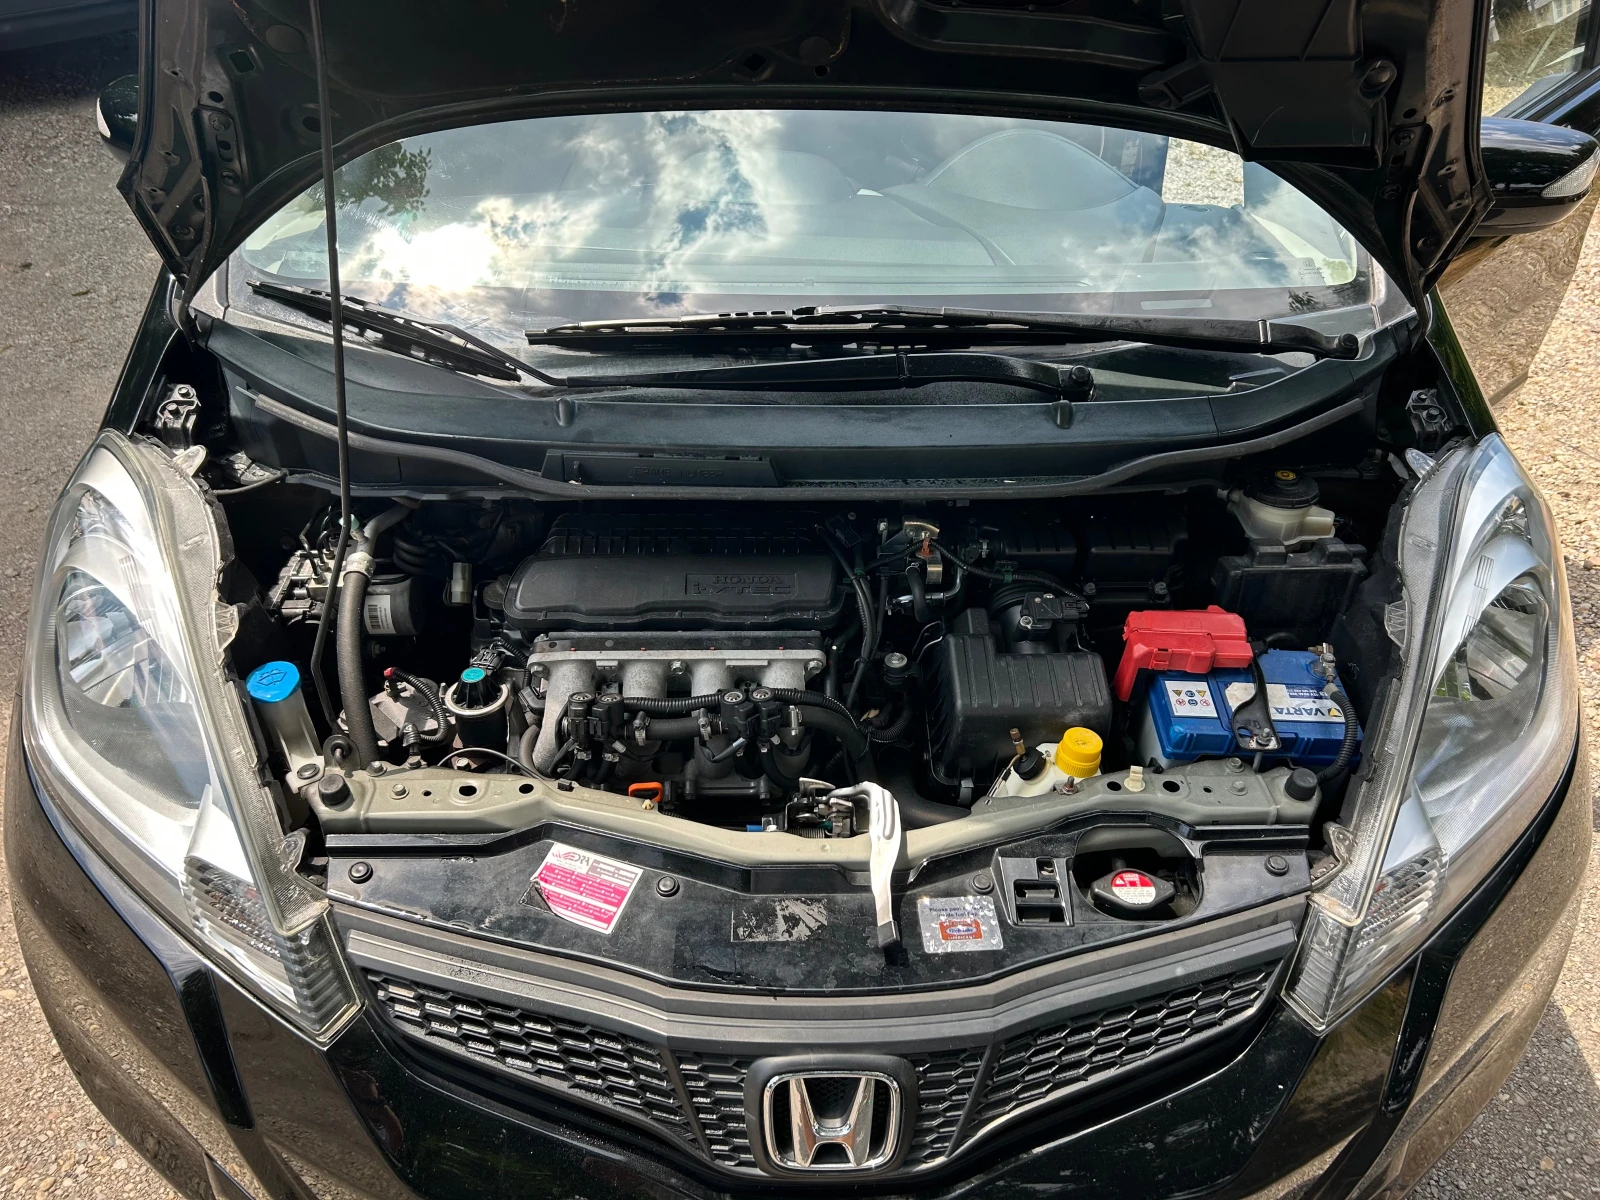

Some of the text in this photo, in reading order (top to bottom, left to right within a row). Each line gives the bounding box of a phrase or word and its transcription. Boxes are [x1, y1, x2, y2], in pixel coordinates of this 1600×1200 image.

[634, 466, 724, 478] FRAME NUMBER
[712, 576, 783, 584] HONDA
[1273, 706, 1326, 717] VARTA
